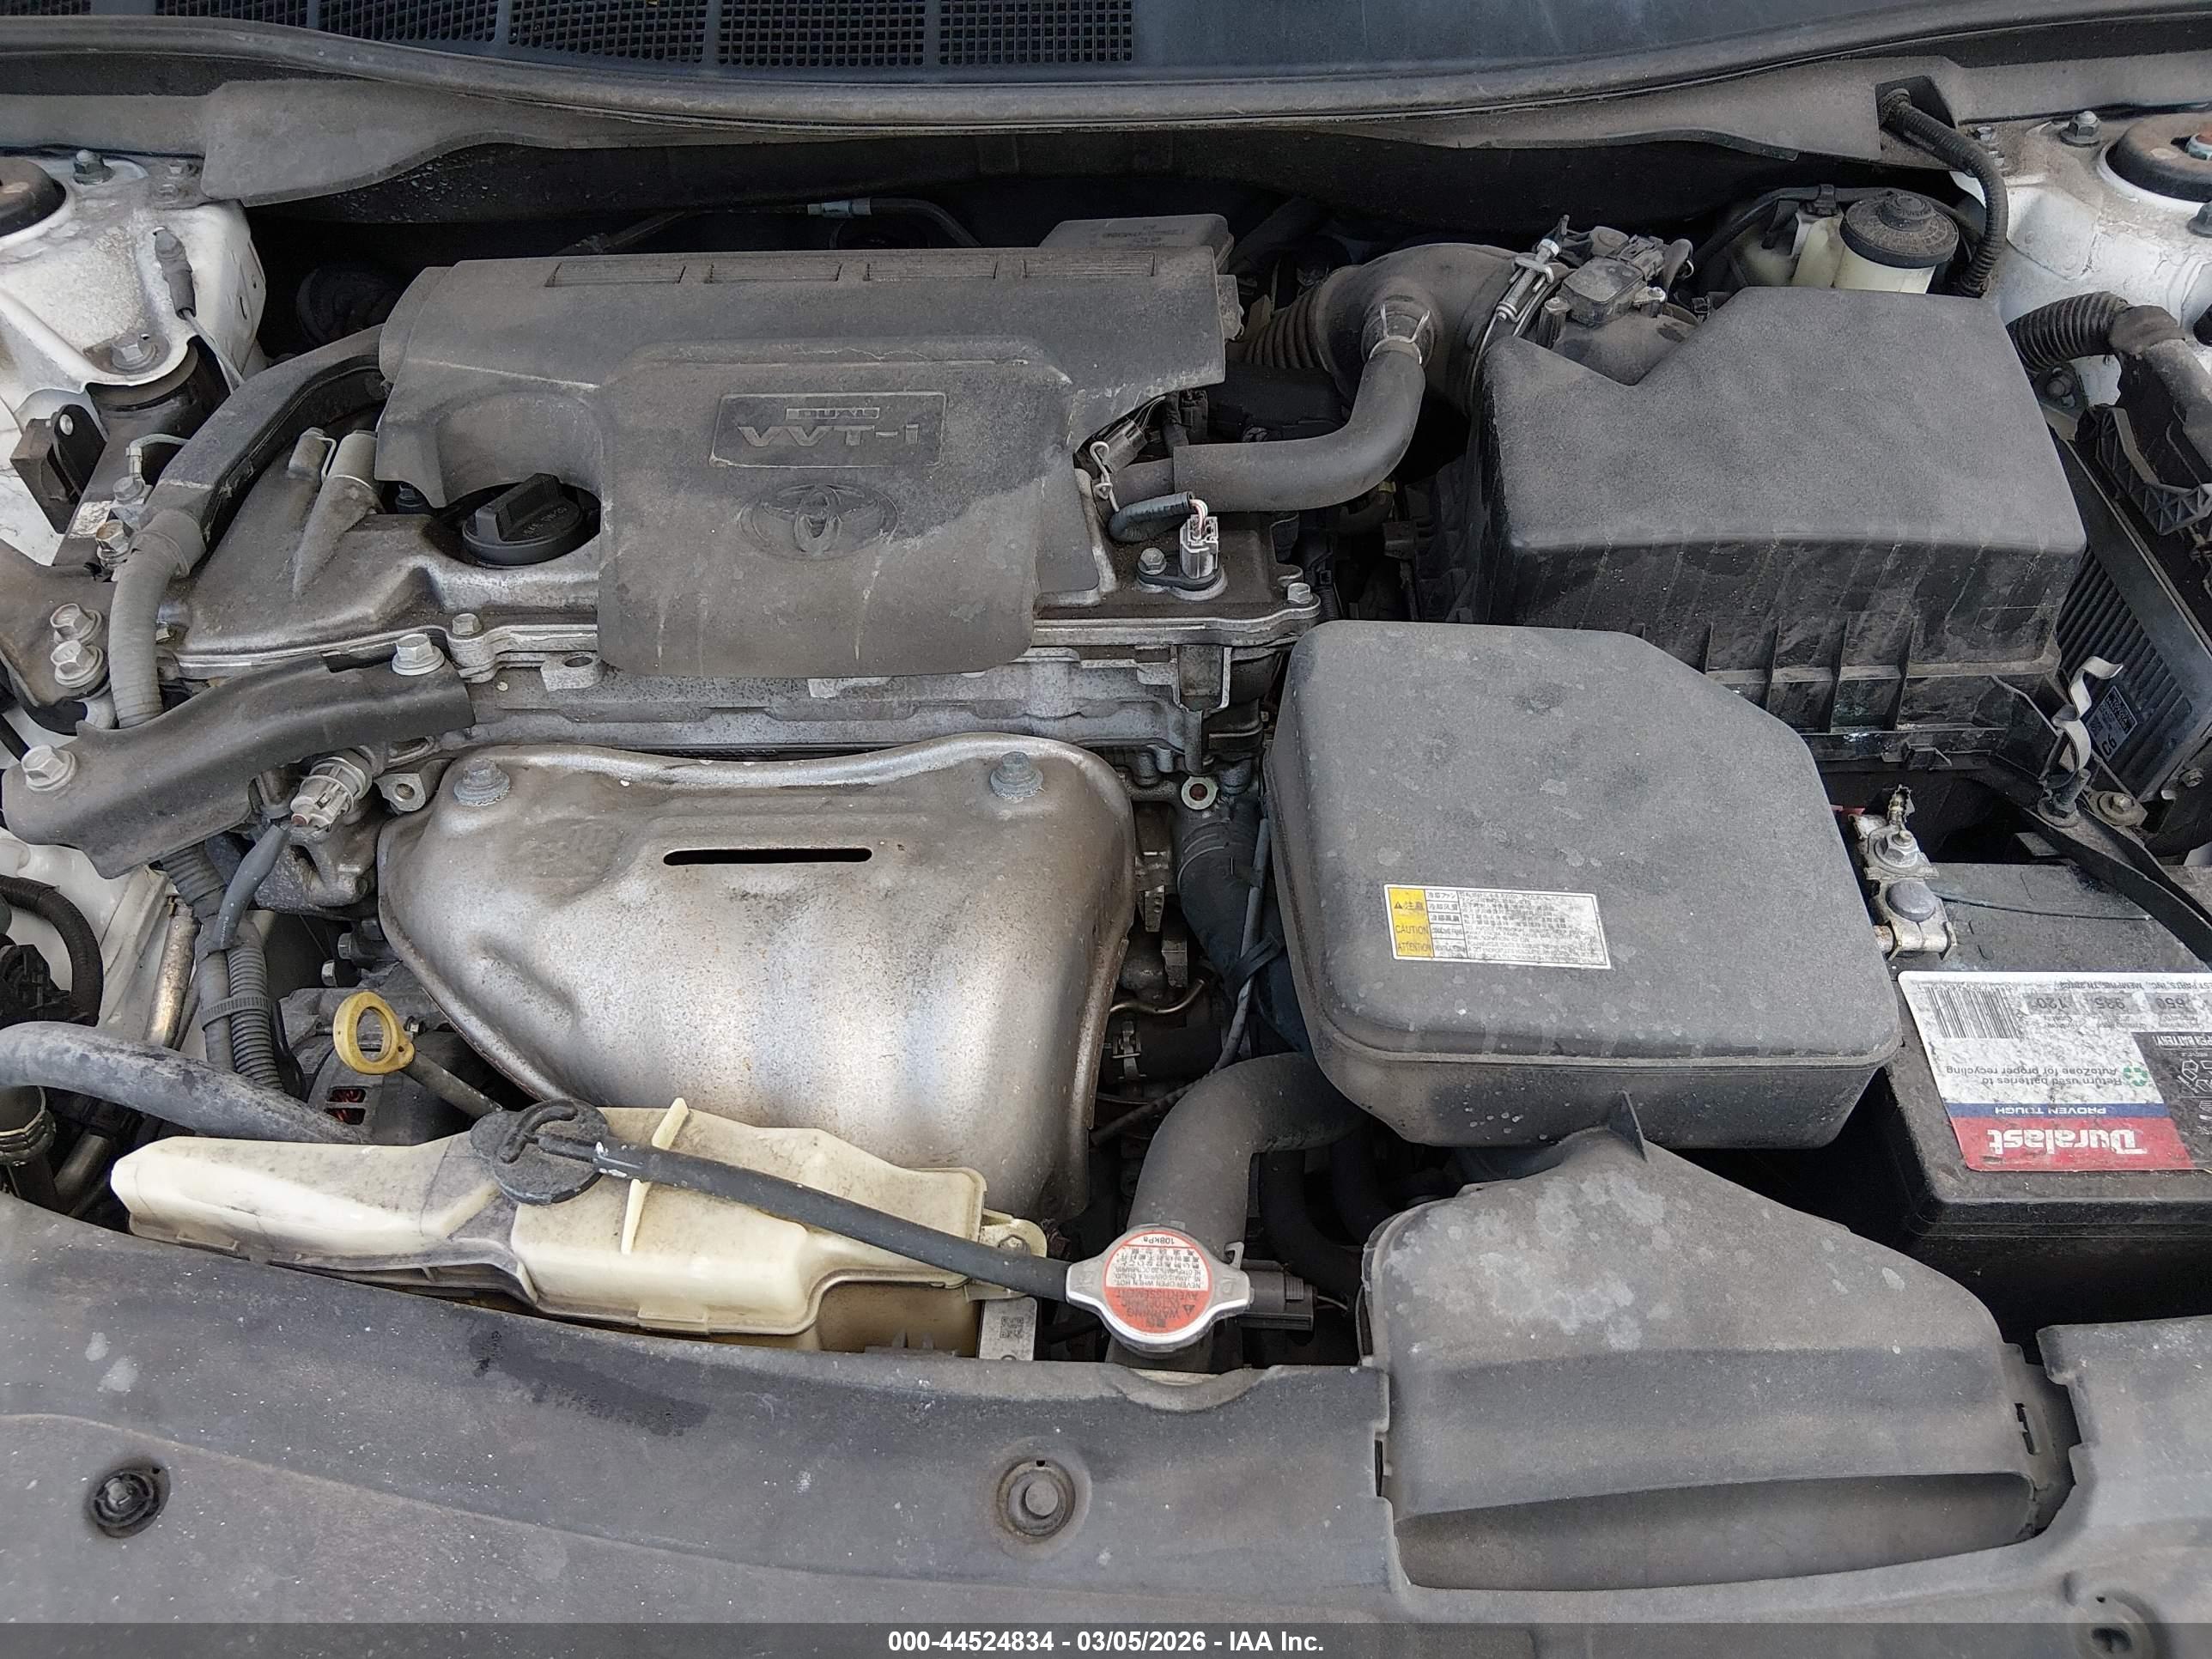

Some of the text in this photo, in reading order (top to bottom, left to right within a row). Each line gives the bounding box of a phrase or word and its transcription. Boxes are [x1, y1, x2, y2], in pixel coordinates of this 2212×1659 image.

[2102, 734, 2118, 757] C6
[1395, 925, 1429, 935] CAUTION
[1398, 941, 1431, 952] ATTENTION
[2156, 997, 2186, 1010] 650
[1946, 1065, 2118, 1077] AutoZone for proper recycling
[1982, 1077, 2122, 1086] Return used batteries to
[1995, 1106, 2045, 1115] TOUGH
[1987, 1128, 2148, 1154] Duralast
[1127, 1308, 1178, 1319] WARNING
